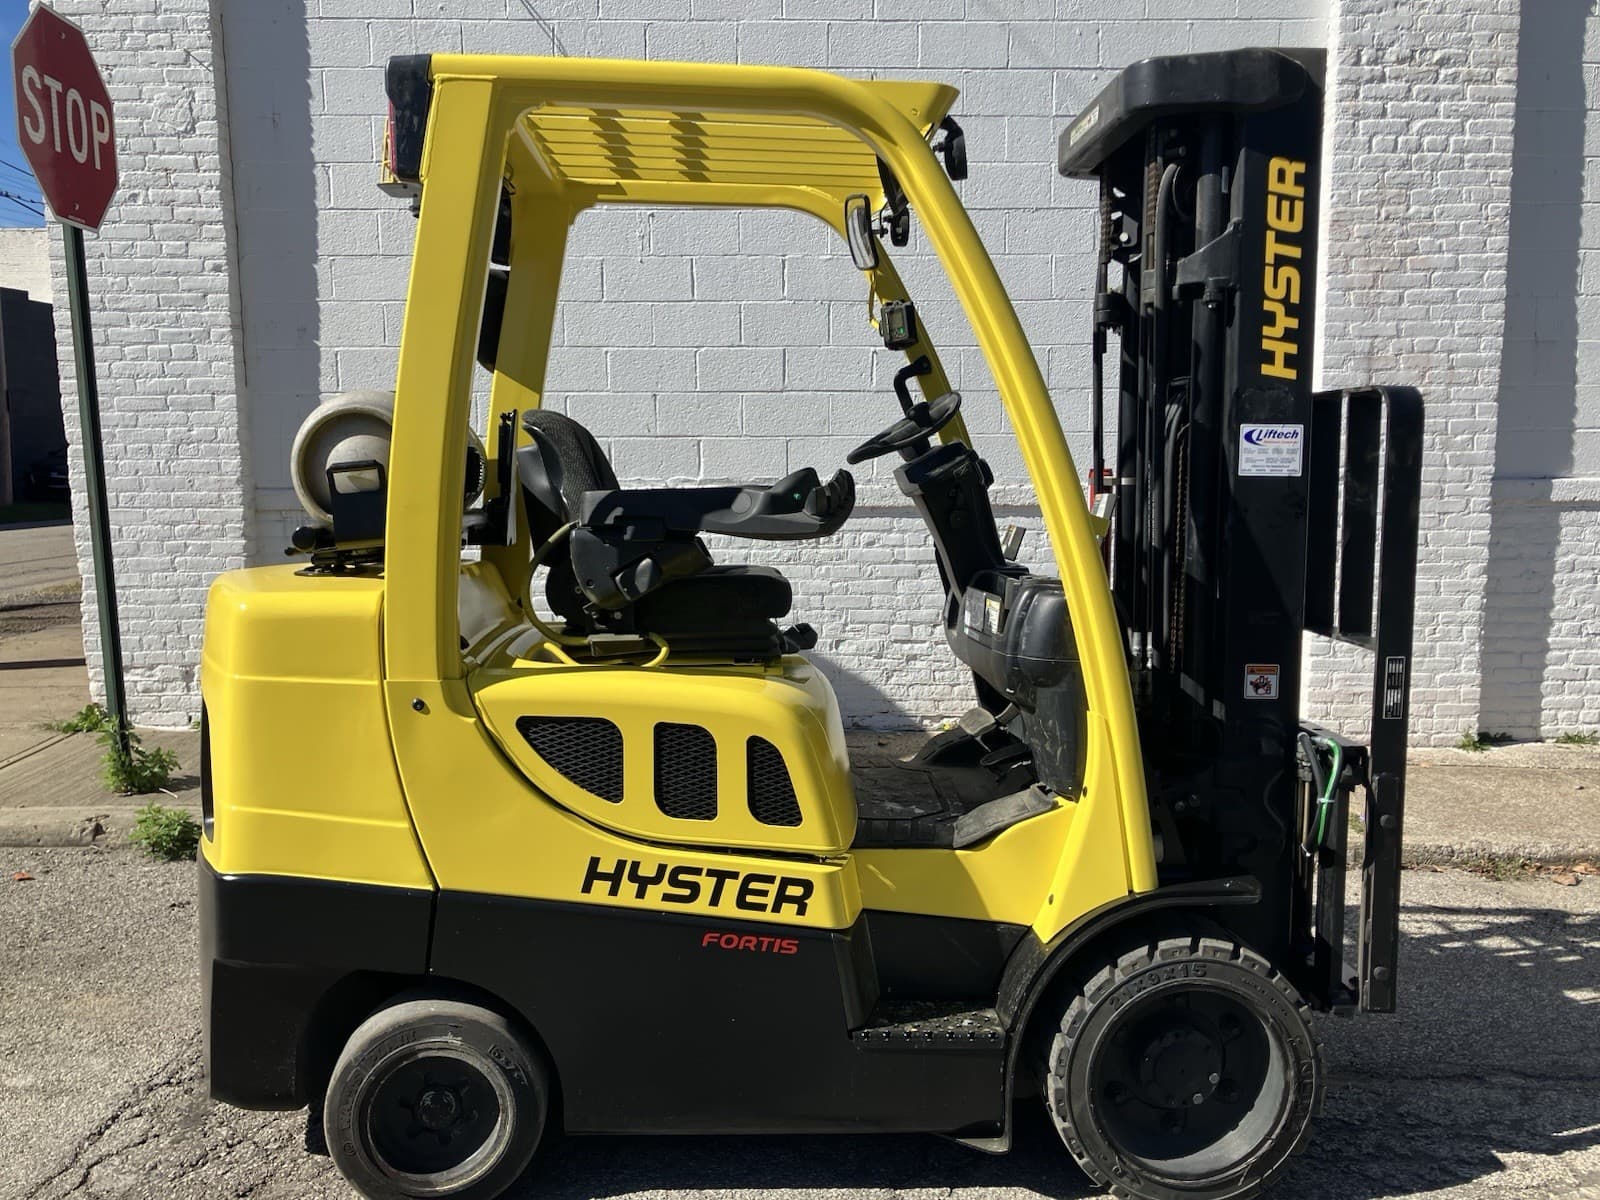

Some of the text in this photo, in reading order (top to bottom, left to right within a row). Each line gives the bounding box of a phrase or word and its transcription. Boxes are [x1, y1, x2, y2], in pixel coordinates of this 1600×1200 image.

[22, 65, 110, 170] STOP
[1261, 156, 1306, 380] HYSTER
[1255, 429, 1299, 442] Liftech
[581, 856, 814, 916] HYSTER
[702, 932, 799, 954] FORTIS
